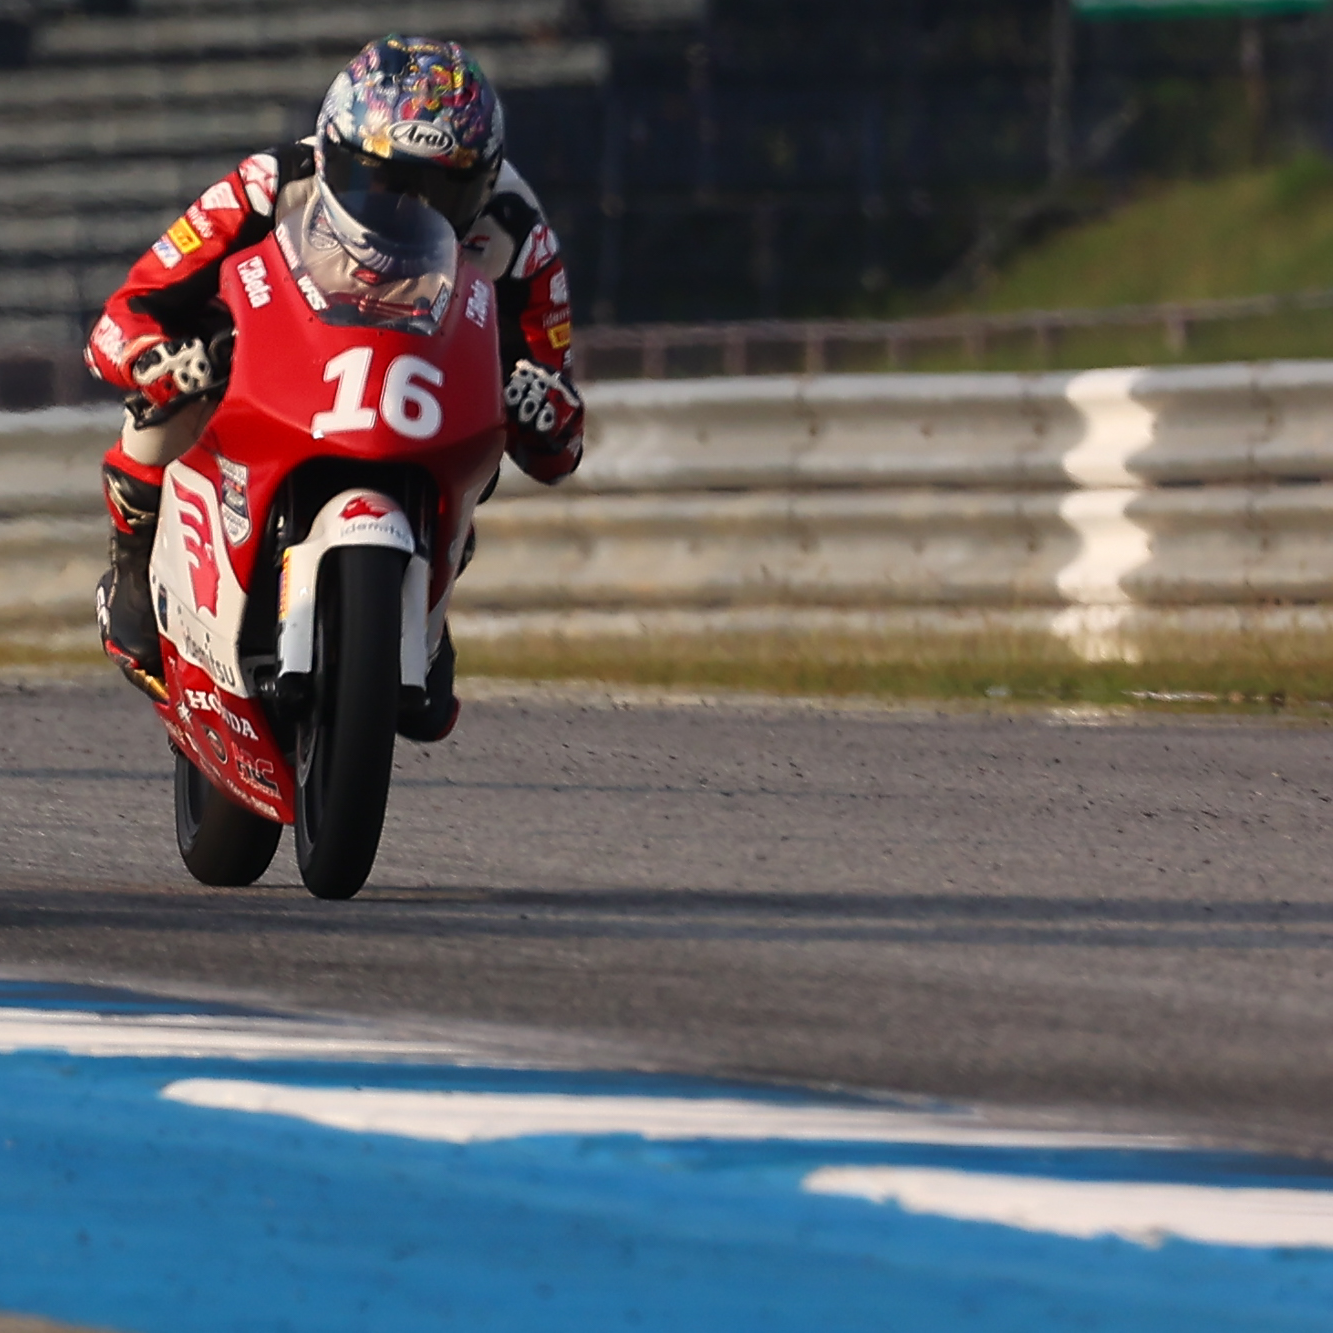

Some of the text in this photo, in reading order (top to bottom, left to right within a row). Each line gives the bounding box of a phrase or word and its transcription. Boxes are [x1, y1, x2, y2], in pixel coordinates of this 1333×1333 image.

[393, 124, 446, 147] Arai
[242, 263, 273, 308] Beta
[297, 275, 329, 311] WRS
[312, 347, 444, 439] 16
